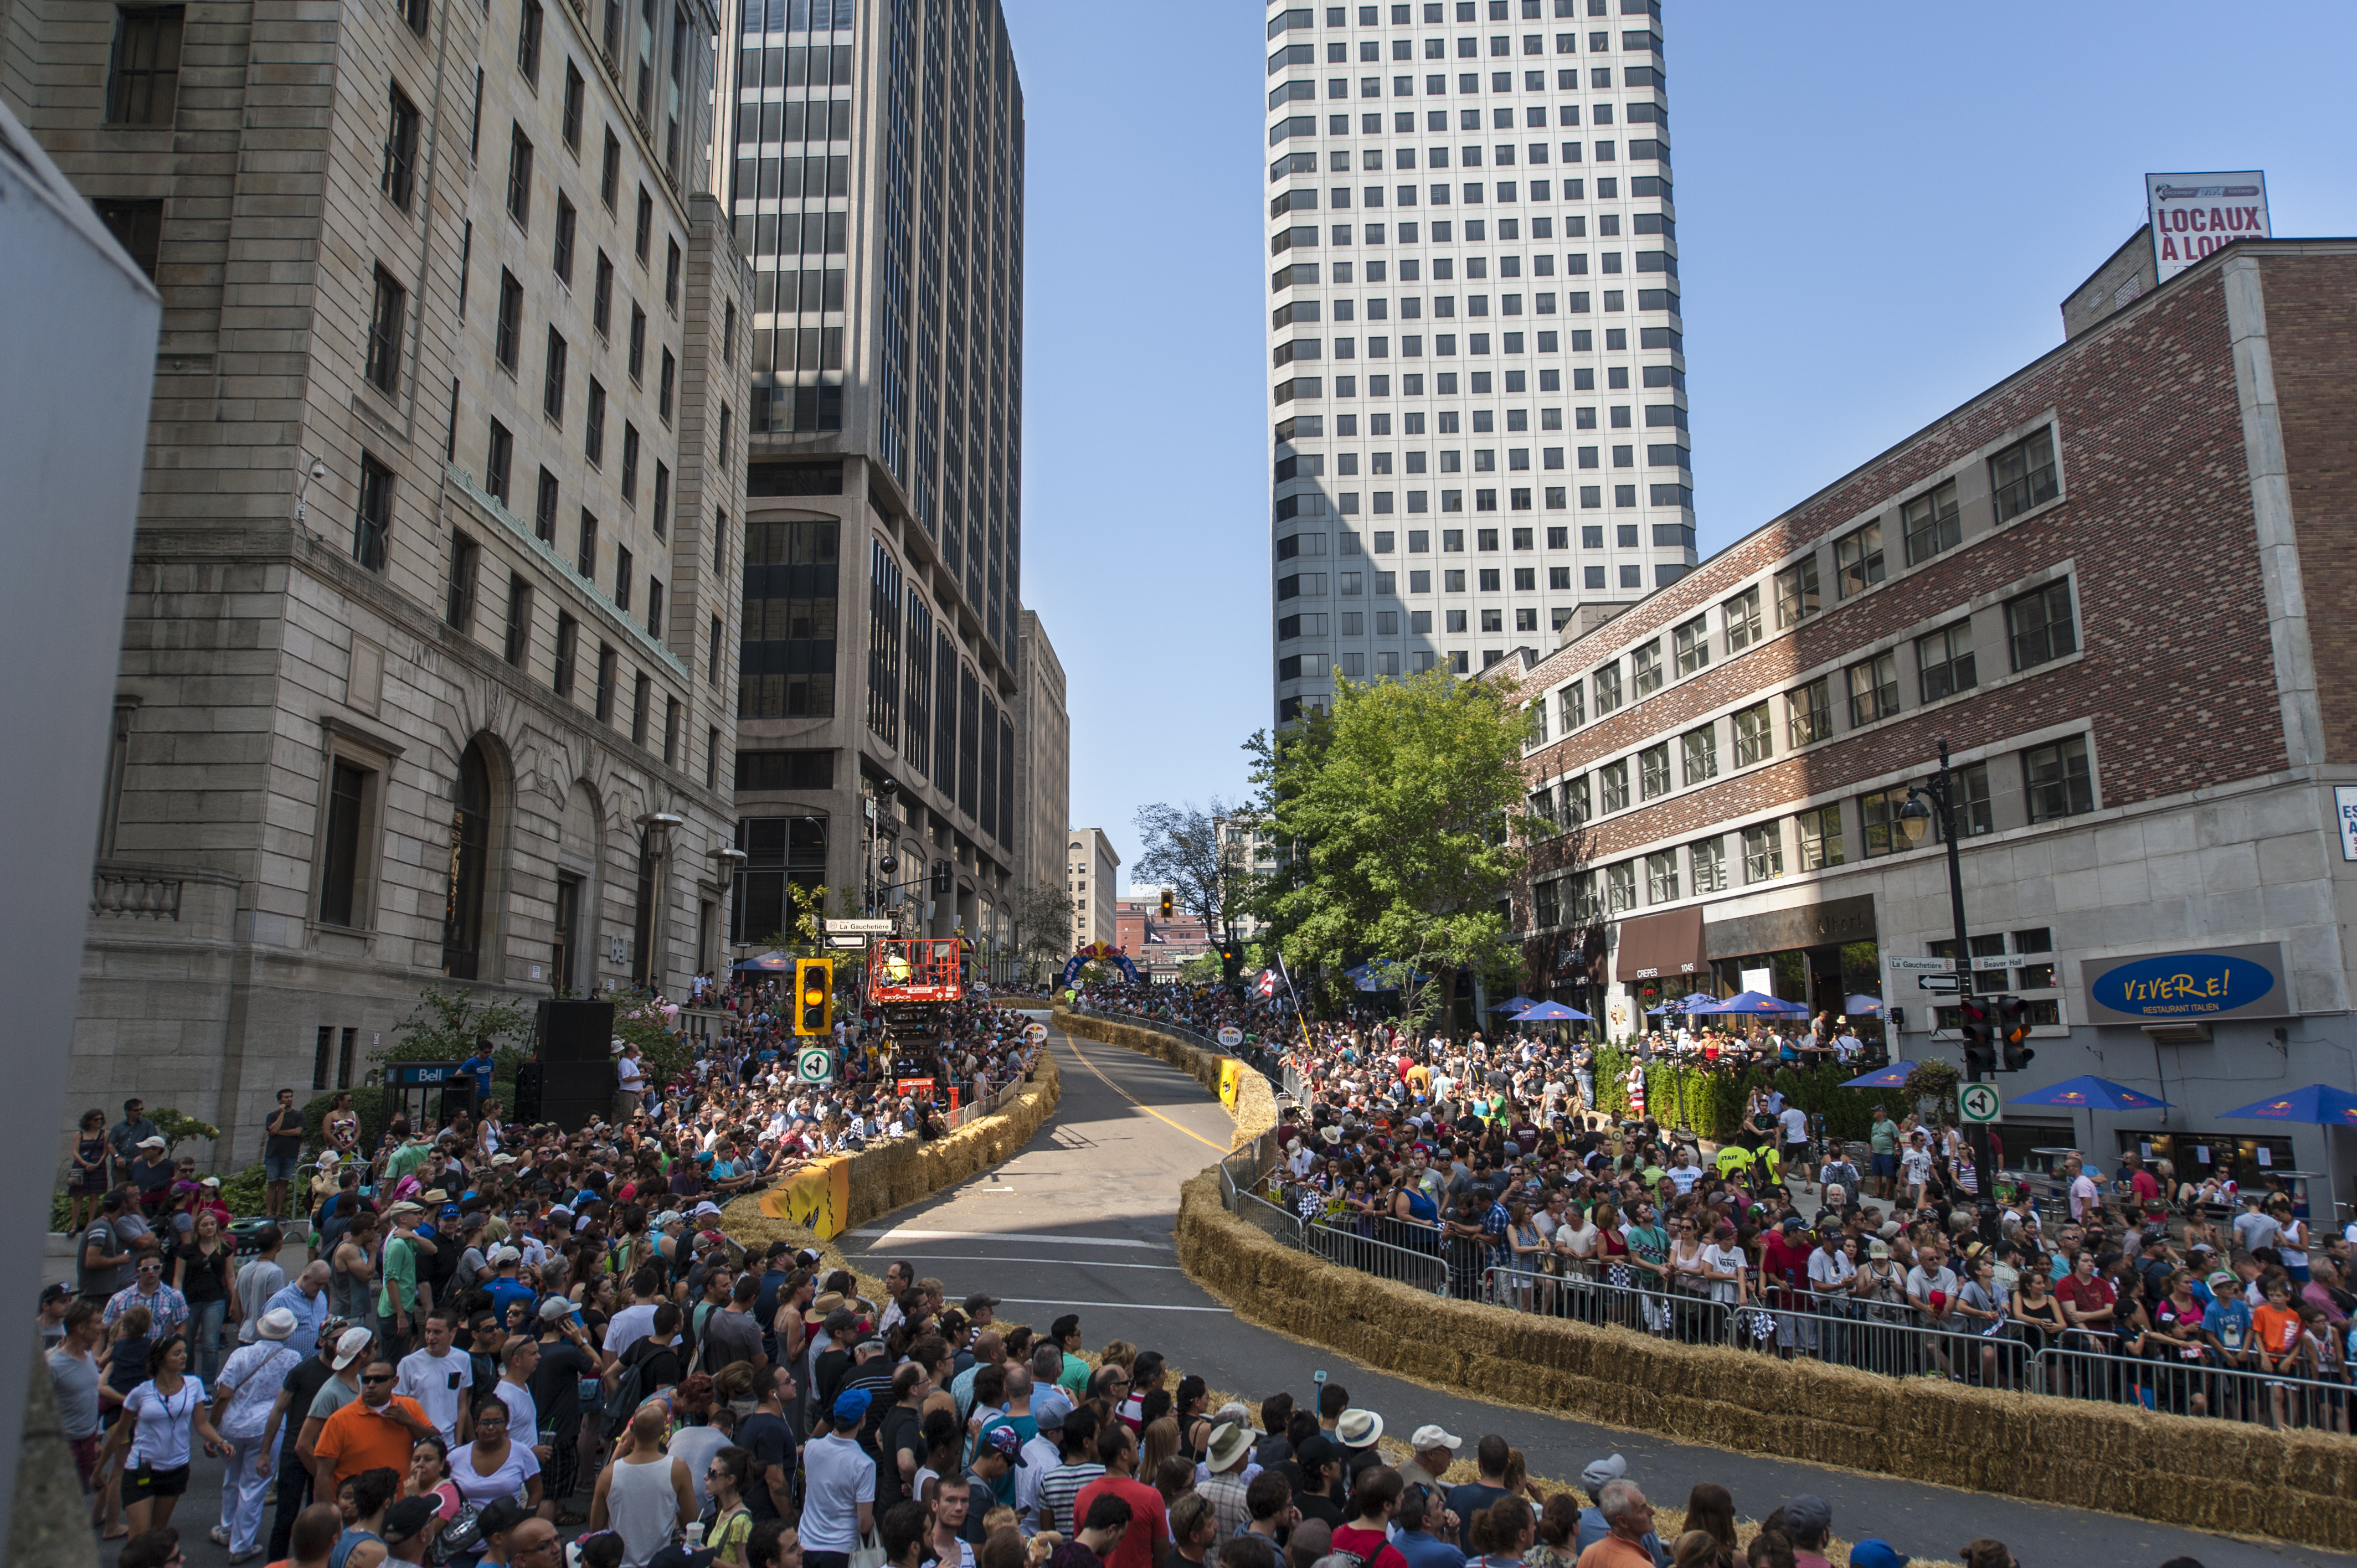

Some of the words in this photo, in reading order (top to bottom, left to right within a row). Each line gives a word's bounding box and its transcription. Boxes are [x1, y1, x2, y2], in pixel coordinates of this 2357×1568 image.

[2158, 207, 2262, 232] LOCAUX
[2162, 233, 2179, 260] À
[2184, 235, 2263, 260] LOU
[610, 935, 627, 963] Bell
[1681, 963, 1694, 972] 1045
[1903, 961, 1942, 969] Gauchetière
[1637, 968, 1658, 978] CREPES
[2143, 1004, 2189, 1014] RESTAURANT
[2191, 1003, 2219, 1012] ITALIEN
[419, 1069, 442, 1081] Bell
[1718, 1256, 1736, 1268] VANS
[2219, 1315, 2241, 1325] PUGS
